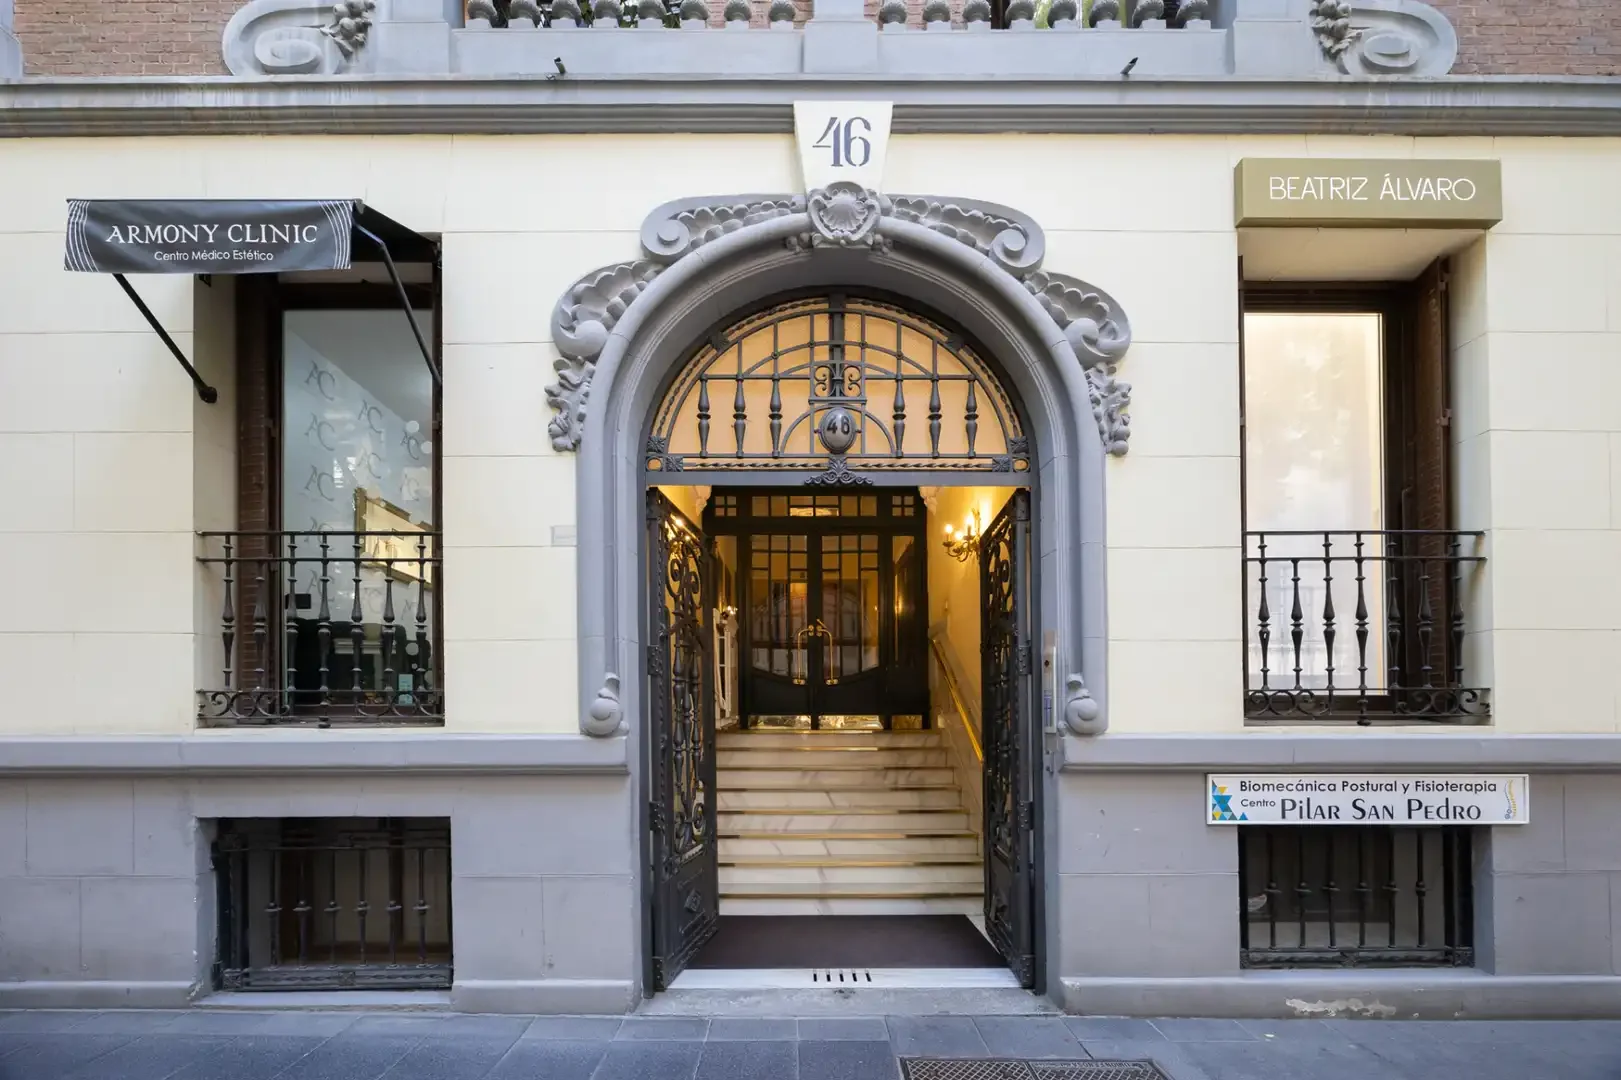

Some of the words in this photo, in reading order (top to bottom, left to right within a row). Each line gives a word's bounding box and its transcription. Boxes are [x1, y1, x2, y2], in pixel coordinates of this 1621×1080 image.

[812, 116, 872, 167] 46
[1269, 176, 1369, 200] BEATRIZ
[1379, 173, 1476, 201] ÁLVARO
[105, 224, 219, 244] ARMONY
[227, 224, 318, 244] CLINIC
[154, 251, 189, 261] Centro
[191, 249, 230, 261] Médico
[232, 249, 274, 261] Estético
[826, 415, 850, 435] 46
[1240, 779, 1337, 792] Biomecánica
[1342, 780, 1397, 792] Postural
[1401, 783, 1410, 794] y
[1415, 780, 1497, 794] Fisioterapia
[1240, 798, 1276, 807] Centro
